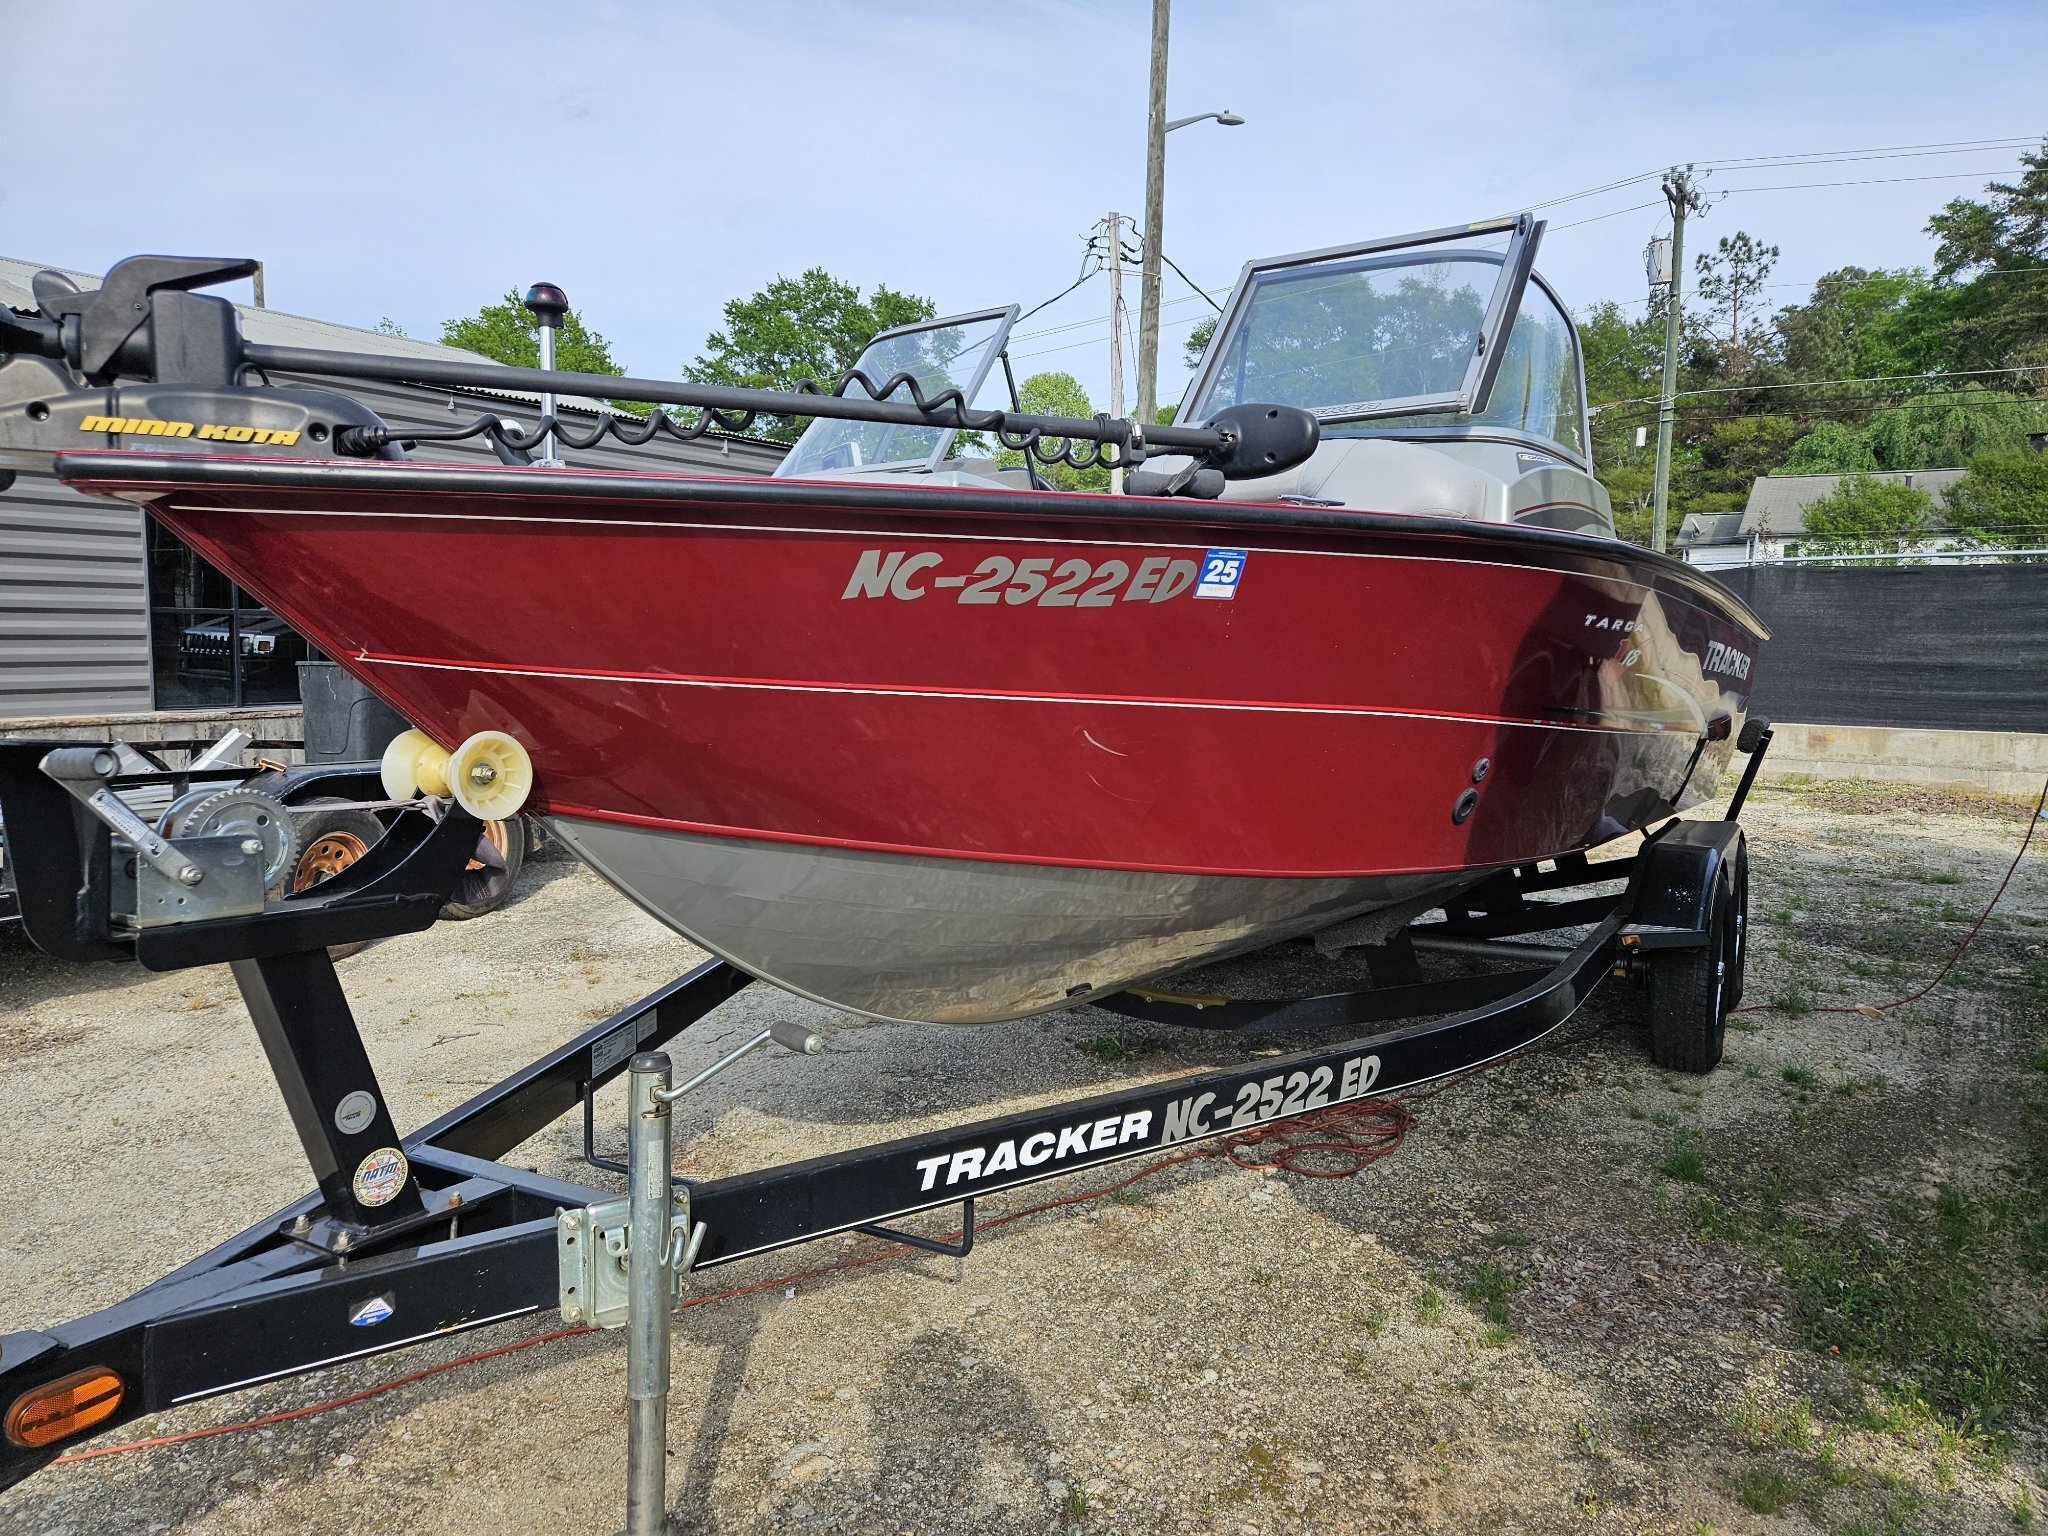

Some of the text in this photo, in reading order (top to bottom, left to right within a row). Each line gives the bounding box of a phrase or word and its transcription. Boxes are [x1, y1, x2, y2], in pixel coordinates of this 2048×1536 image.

[79, 416, 301, 446] MINN KOTA
[1203, 559, 1240, 583] 25
[1584, 614, 1644, 632] TARGA
[1702, 640, 1751, 681] TRACKER
[916, 1054, 1381, 1192] TRACKER NC-2522 ED
